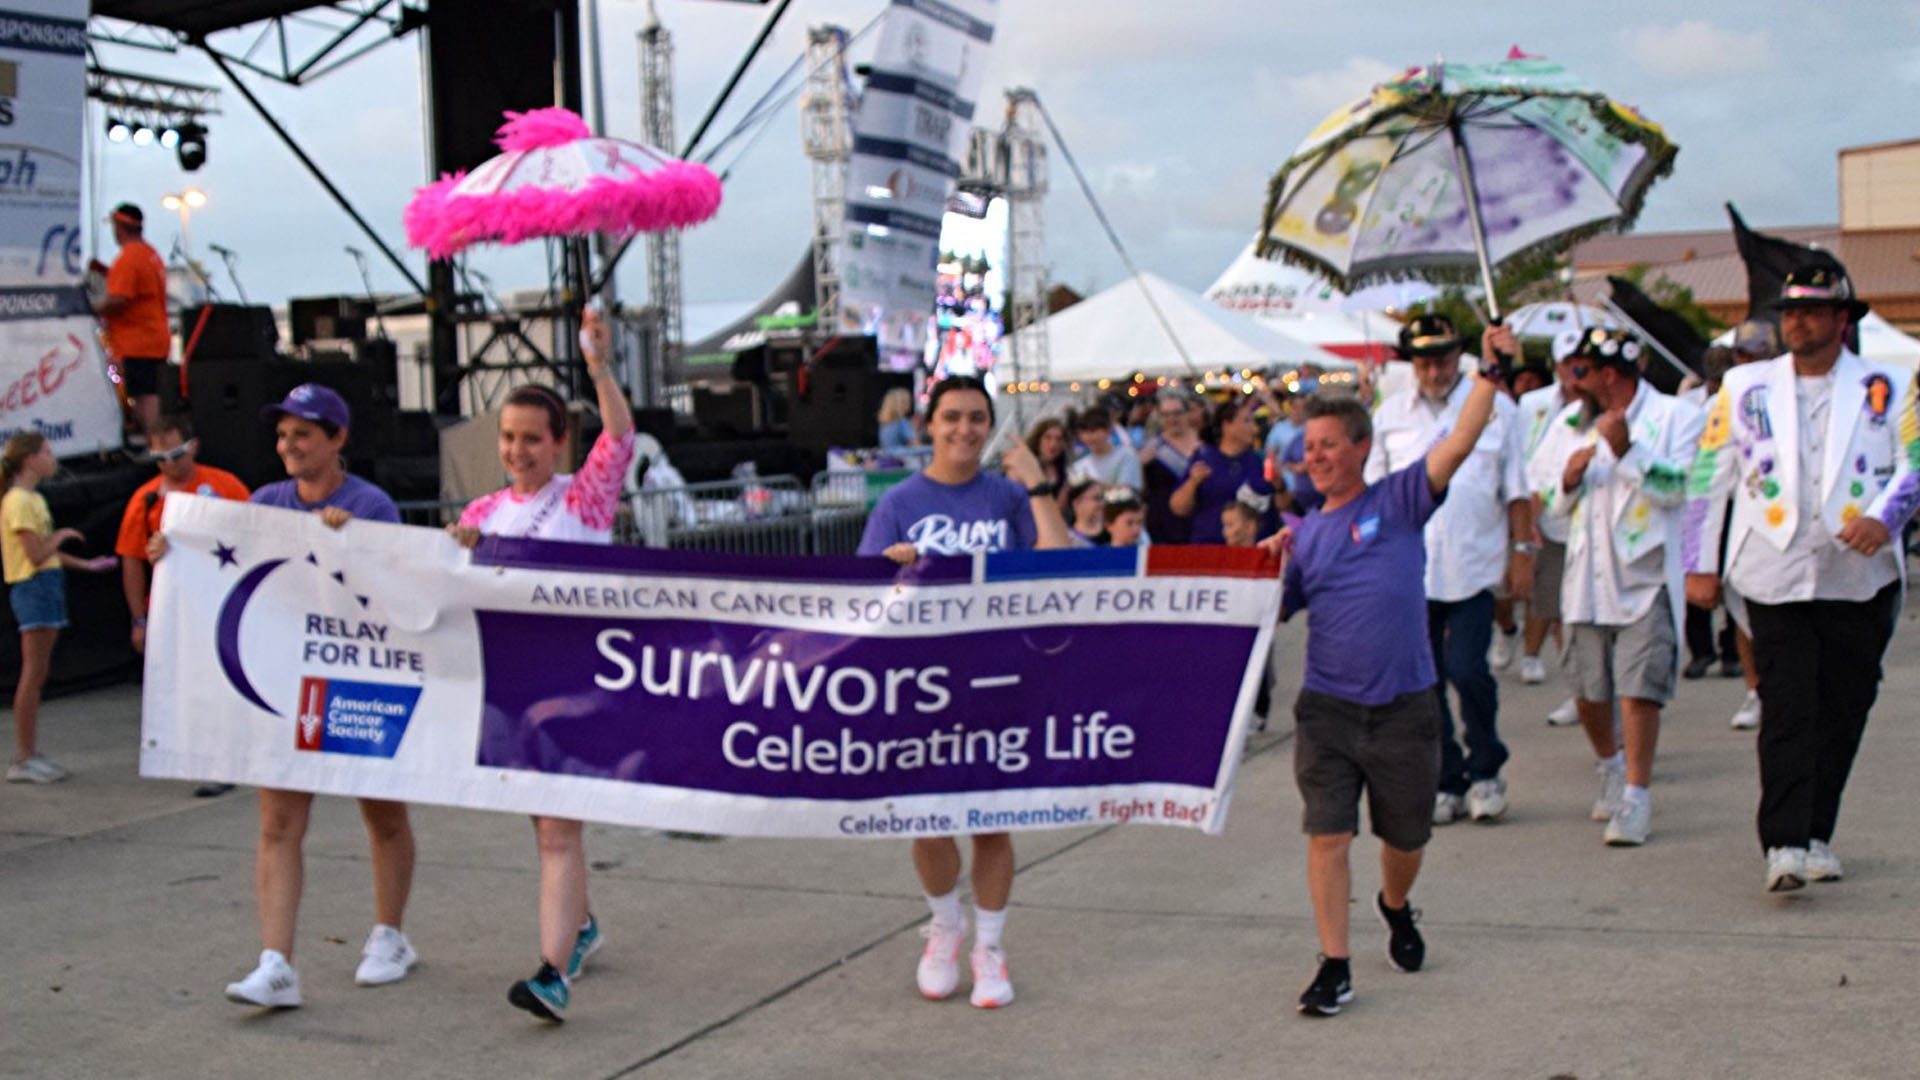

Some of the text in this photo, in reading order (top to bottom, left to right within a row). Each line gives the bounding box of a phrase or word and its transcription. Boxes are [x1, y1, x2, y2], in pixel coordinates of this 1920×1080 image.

[530, 583, 1230, 625] AMERICAN CANCER SOCIETY RELAY FOR LIFE
[306, 613, 388, 642] RELAY
[303, 641, 424, 673] FOR LIFE
[593, 627, 951, 716] Survivors
[328, 709, 385, 727] Cancer
[329, 695, 406, 717] American
[327, 722, 386, 745] Society
[722, 711, 1136, 775] Celebrating Life
[838, 812, 959, 834] Celebrate.
[967, 804, 1093, 828] Remember.
[1099, 799, 1156, 824] Fight
